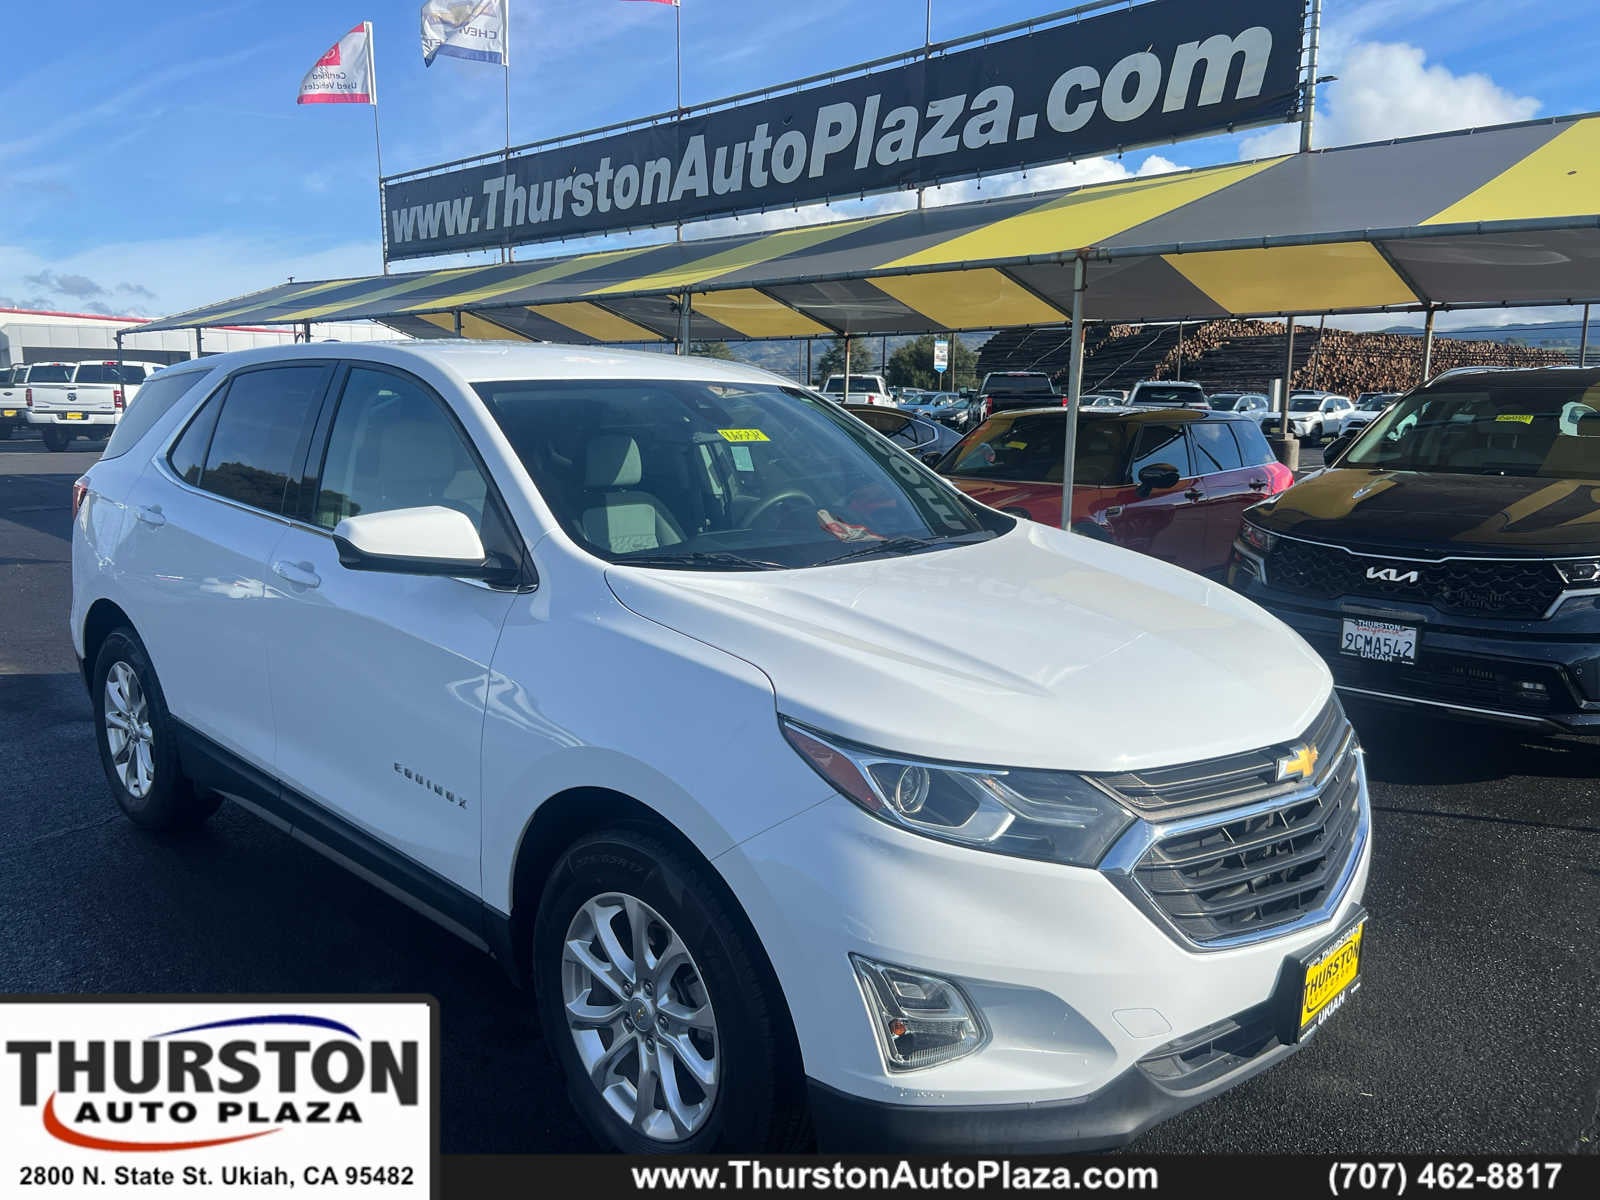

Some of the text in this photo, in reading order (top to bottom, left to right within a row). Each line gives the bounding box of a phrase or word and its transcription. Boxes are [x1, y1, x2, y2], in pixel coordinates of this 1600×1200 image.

[391, 26, 1273, 243] www.ThurstonAutoPlaza.com
[1345, 632, 1413, 657] 9CMA542
[1358, 620, 1401, 630] THURSTON
[394, 762, 467, 810] EQUINOX
[1303, 941, 1360, 1006] THURSTON
[1318, 990, 1346, 1025] UKIAH
